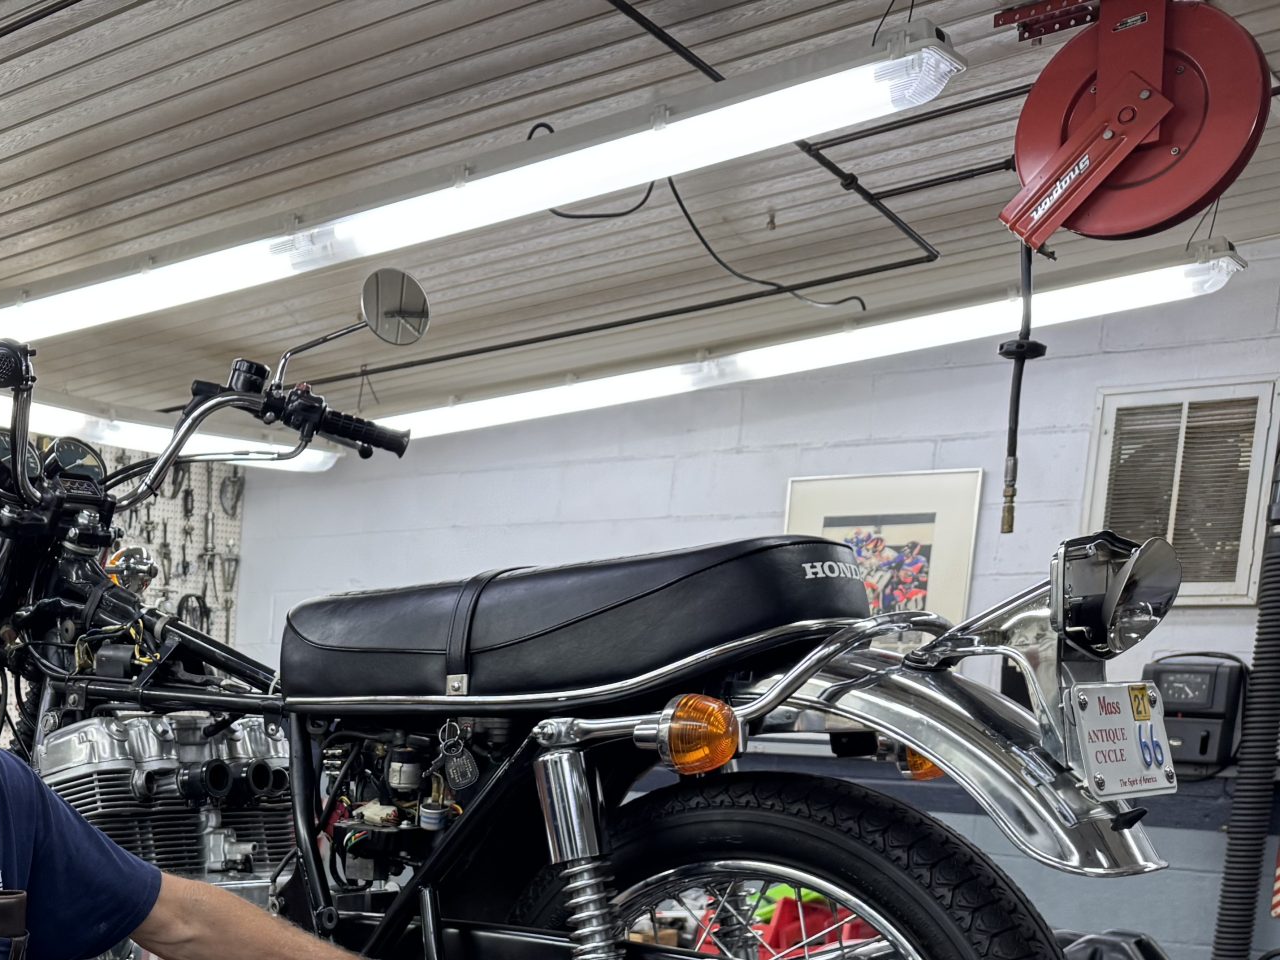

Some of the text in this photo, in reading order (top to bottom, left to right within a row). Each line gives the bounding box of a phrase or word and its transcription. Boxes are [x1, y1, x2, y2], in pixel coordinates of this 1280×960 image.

[1030, 153, 1090, 220] Snap-on
[802, 561, 861, 580] HOND
[1097, 695, 1121, 716] Mass
[1133, 693, 1148, 716] 21
[1087, 727, 1128, 744] ANTIQUE
[1138, 724, 1164, 767] 66
[1095, 748, 1127, 764] CYCLE
[1119, 780, 1127, 788] The
[1128, 777, 1138, 787] Spirit
[1143, 776, 1157, 785] America
